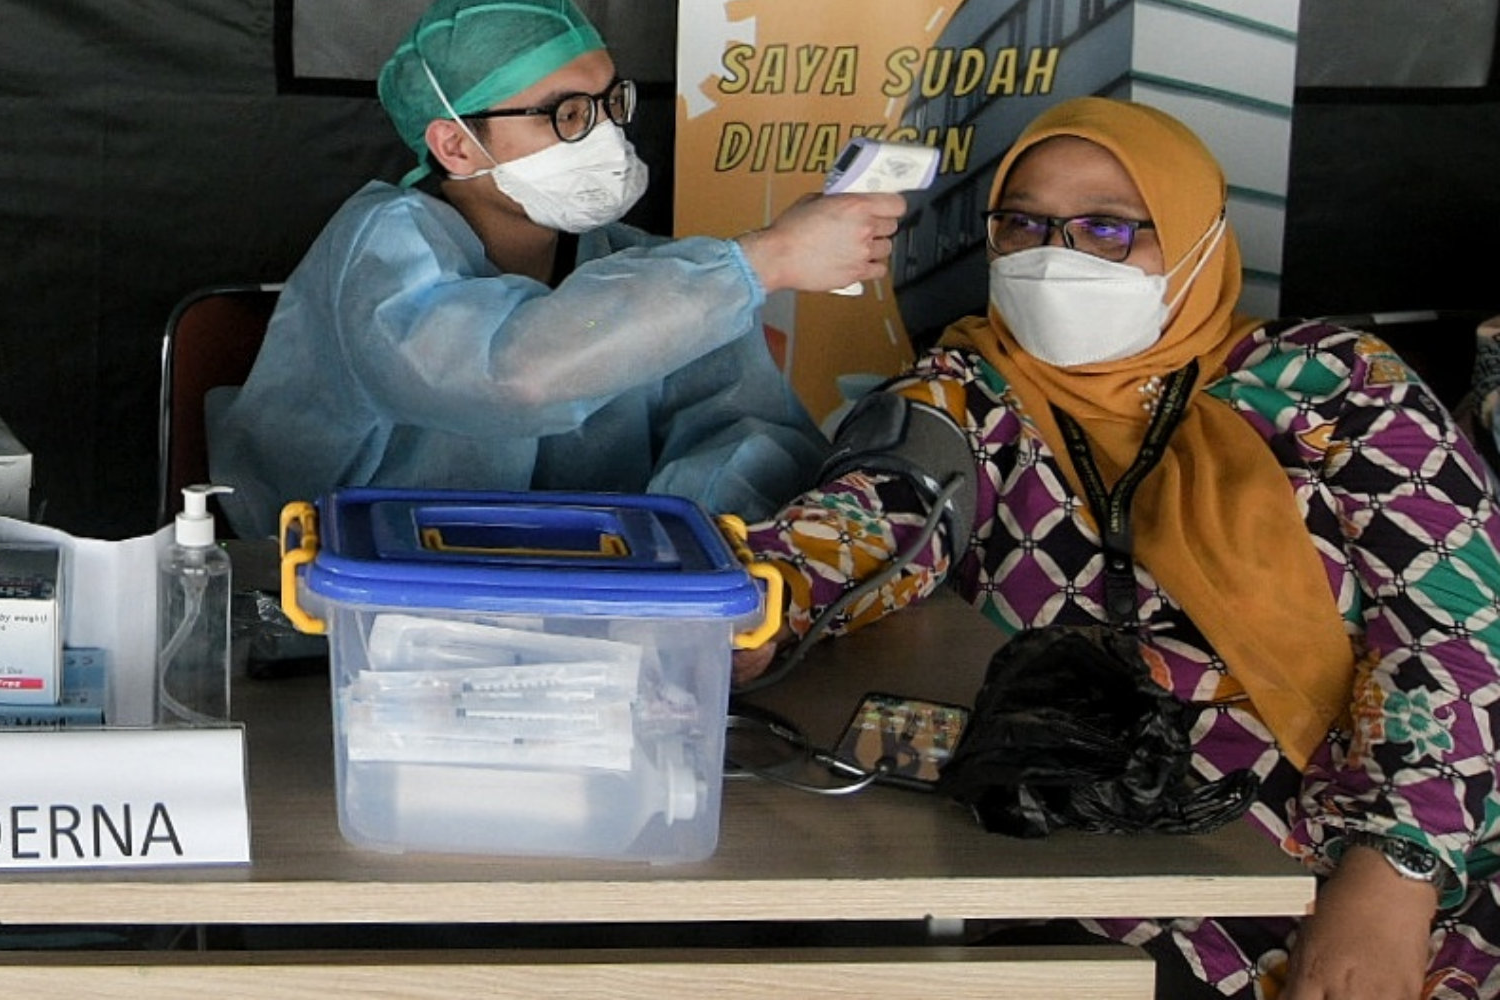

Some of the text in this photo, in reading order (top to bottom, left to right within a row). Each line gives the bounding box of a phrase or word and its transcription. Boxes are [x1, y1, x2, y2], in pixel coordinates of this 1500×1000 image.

[717, 44, 1061, 98] SAYA SUDAH
[714, 121, 976, 173] DIVAN
